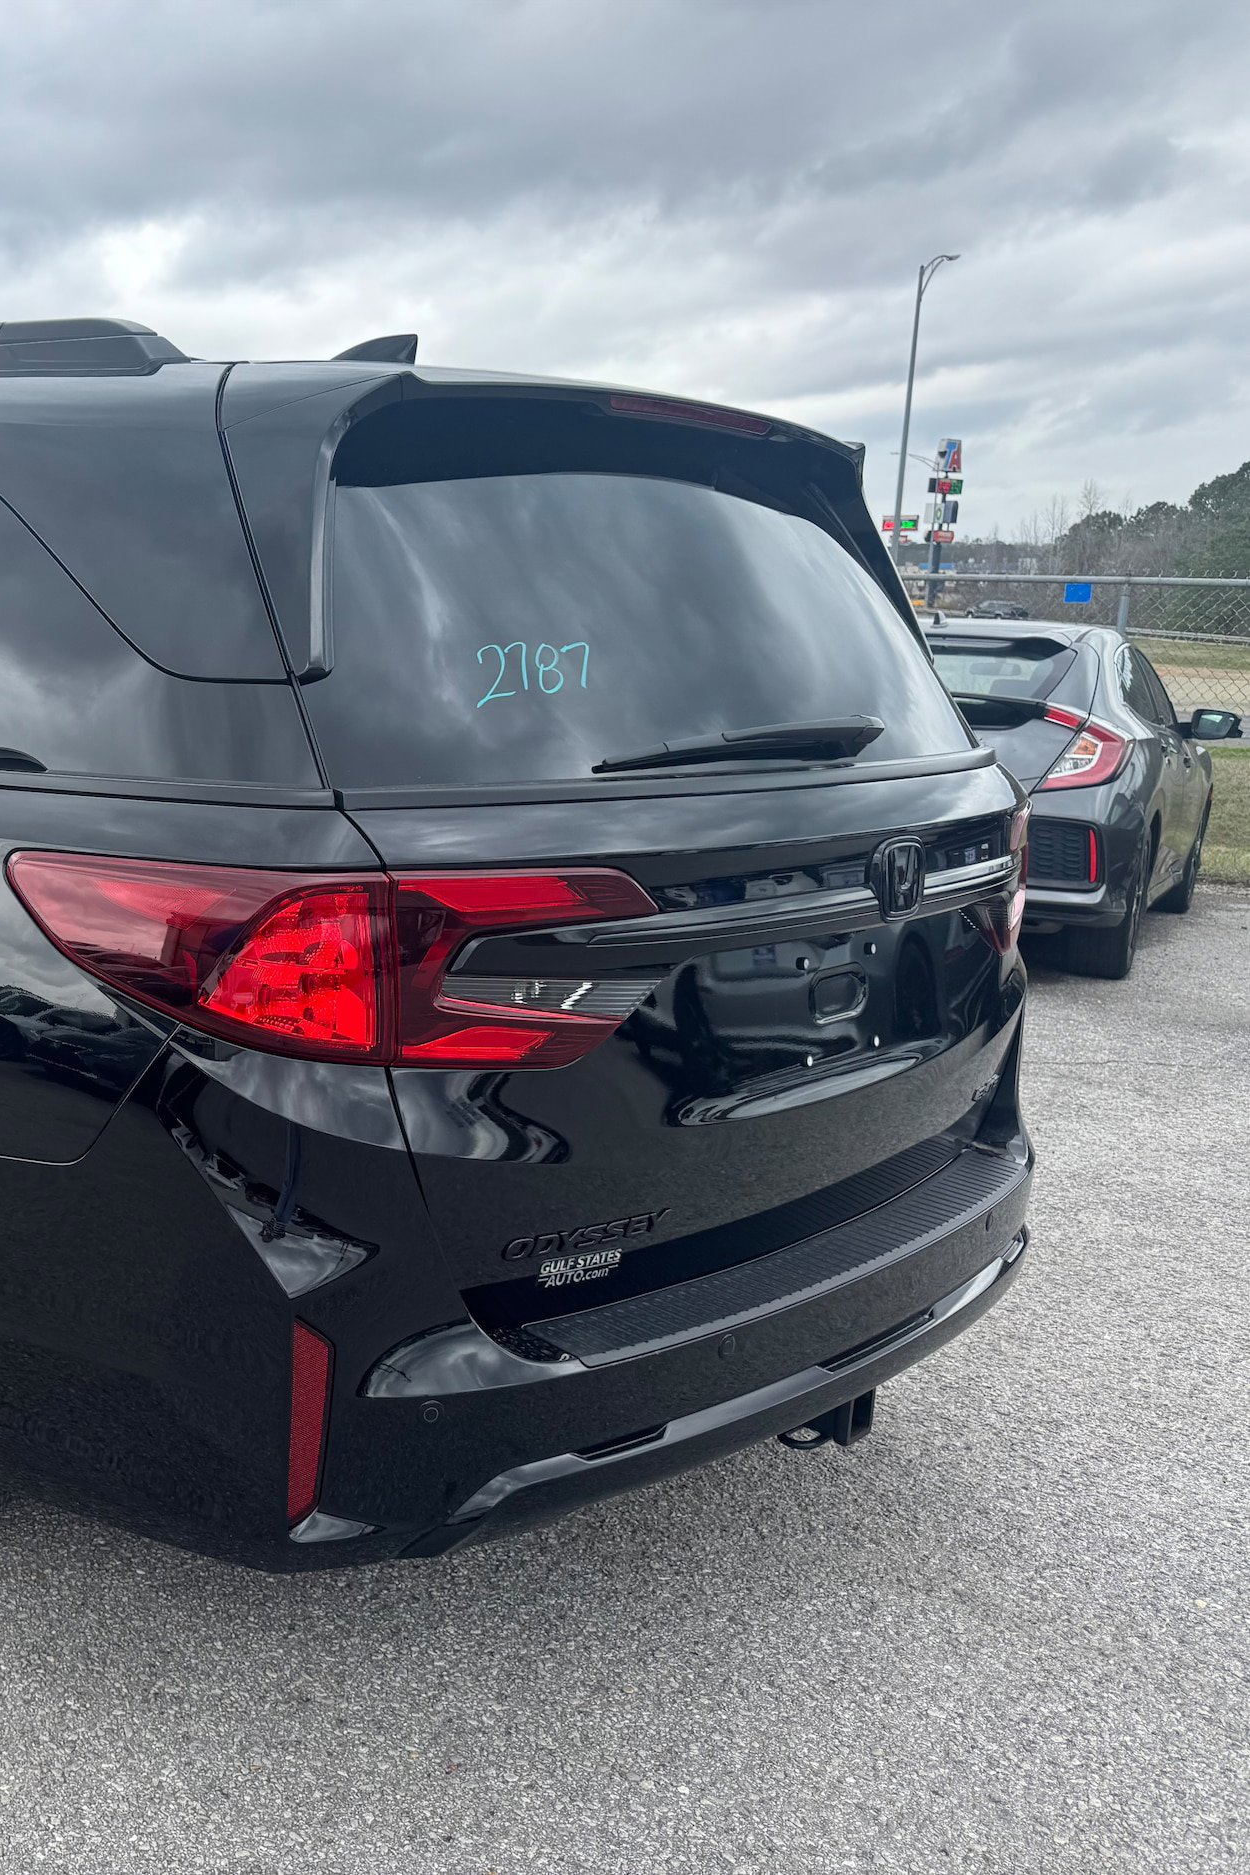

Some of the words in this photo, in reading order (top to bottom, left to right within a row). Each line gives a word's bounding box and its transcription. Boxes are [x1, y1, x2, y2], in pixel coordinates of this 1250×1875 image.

[476, 641, 590, 709] 2787
[501, 1207, 672, 1262] ODYSSEY
[539, 1258, 577, 1275] GULF
[575, 1248, 622, 1268] STATES
[544, 1267, 609, 1288] AUTO.com
